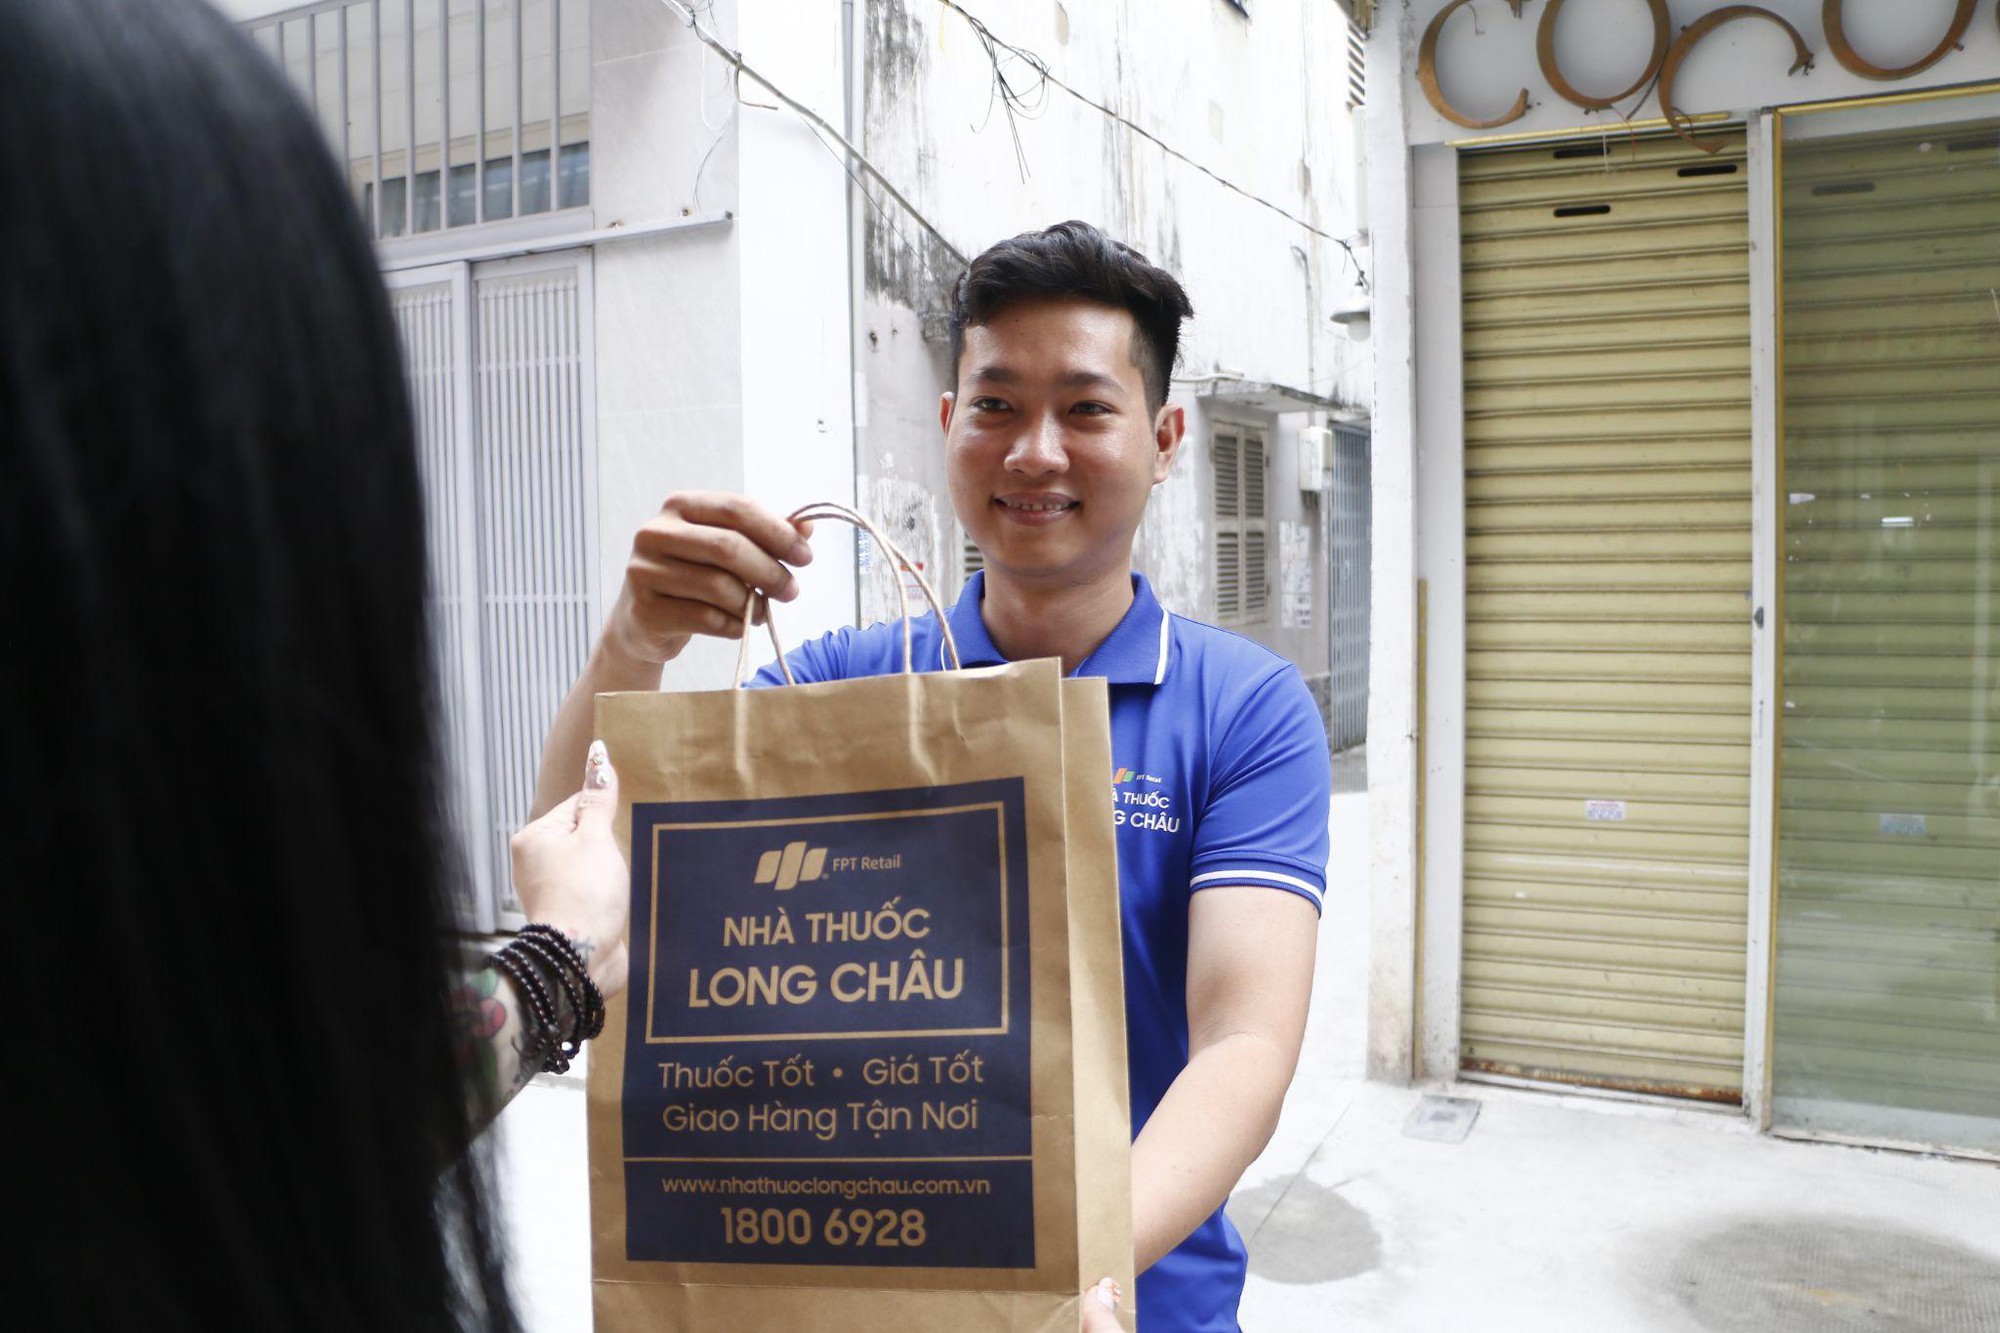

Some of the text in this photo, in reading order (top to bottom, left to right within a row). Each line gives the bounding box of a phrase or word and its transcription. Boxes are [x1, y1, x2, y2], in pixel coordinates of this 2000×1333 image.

[1123, 790, 1170, 809] THUỐC
[1130, 811, 1180, 833] CHÂU
[832, 853, 901, 871] FPT Retail
[723, 896, 931, 946] NHÀ THUỐC
[688, 948, 964, 1008] LONG CHÂU
[658, 1049, 984, 1090] Thuốc Tốt Giá Tốt
[662, 1098, 979, 1141] Giao Hàng Tận Nơi
[661, 1176, 991, 1200] www.nhathuoclongchau.com.vn
[720, 1207, 927, 1247] 1800 6928
